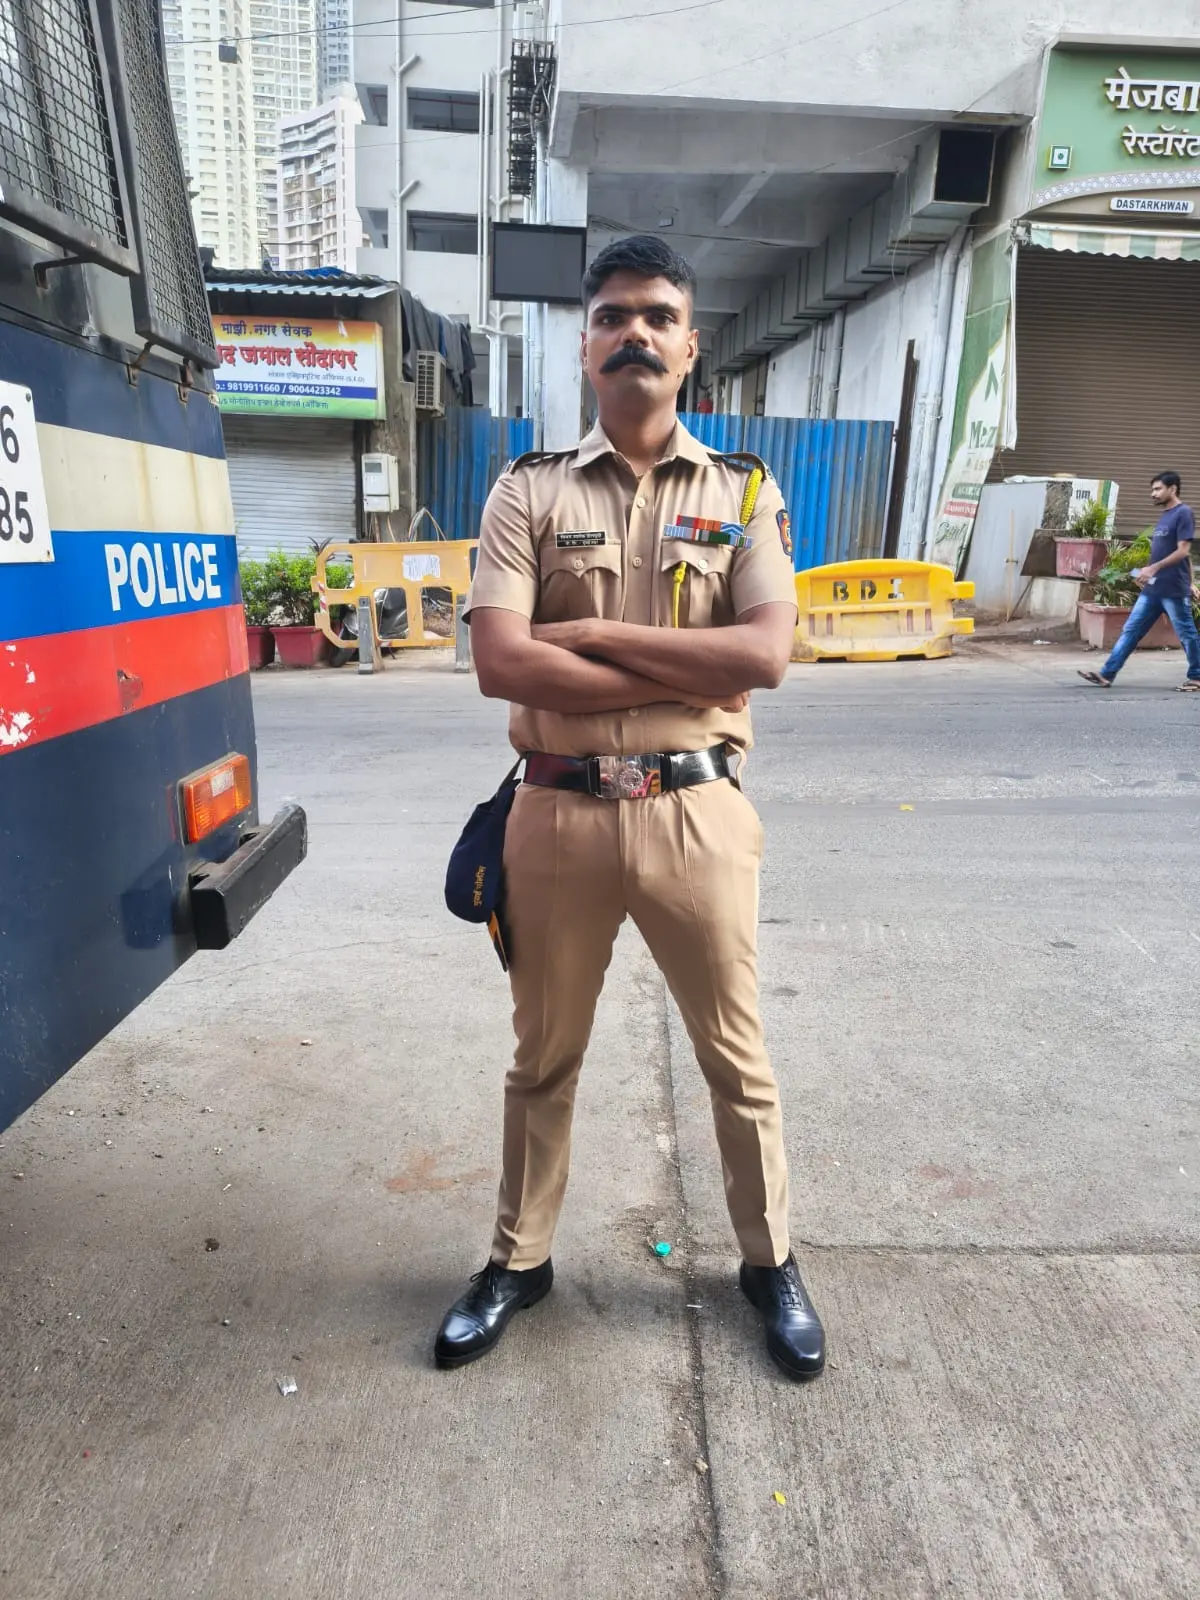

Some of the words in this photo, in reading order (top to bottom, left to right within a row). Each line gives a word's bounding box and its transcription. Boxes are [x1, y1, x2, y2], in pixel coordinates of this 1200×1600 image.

[1116, 199, 1189, 212] DASTARKHWAN
[254, 324, 277, 337] नगर
[281, 321, 313, 337] सेवक
[239, 345, 292, 367] जमाल
[227, 382, 280, 393] 9819911660
[288, 384, 341, 396] 9004423342
[0, 405, 20, 464] 6
[104, 542, 221, 612] POLICE
